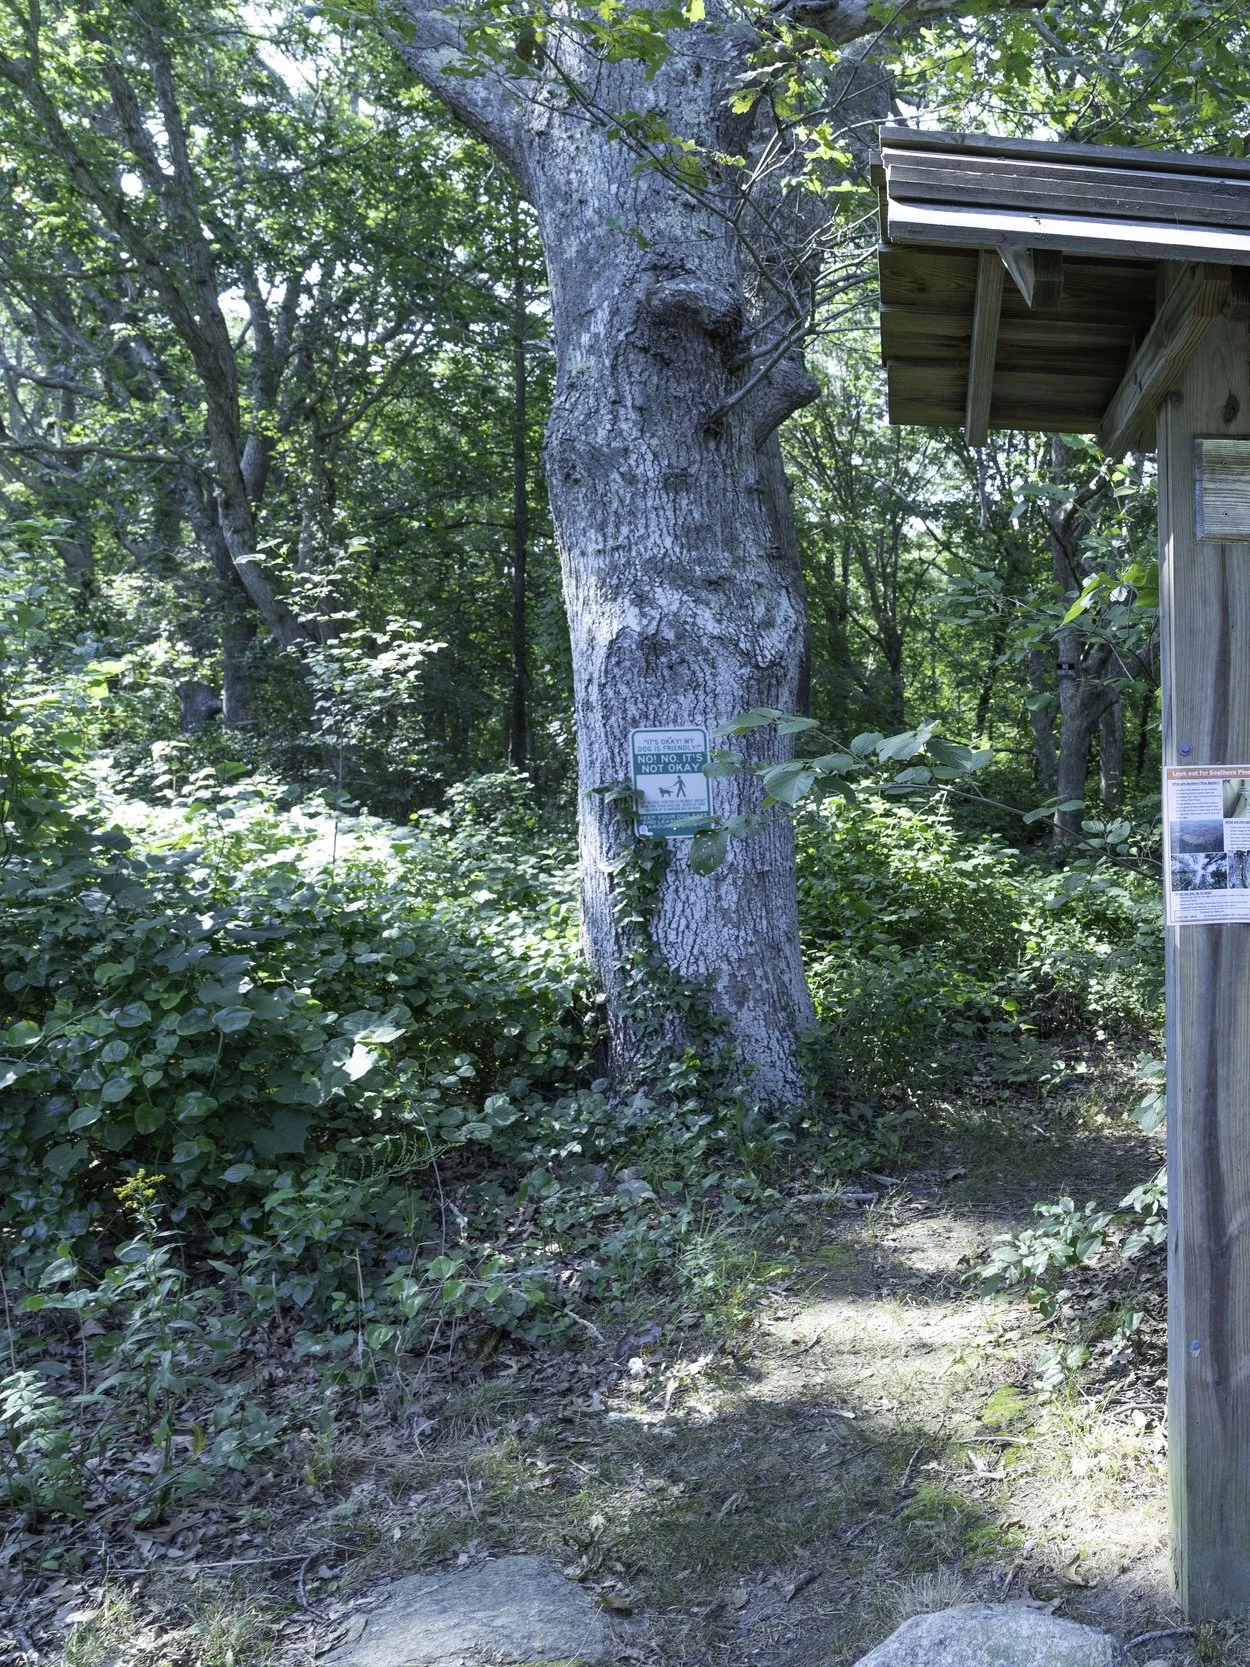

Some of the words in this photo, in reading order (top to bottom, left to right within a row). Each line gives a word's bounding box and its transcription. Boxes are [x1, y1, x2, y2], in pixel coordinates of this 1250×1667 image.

[638, 755, 656, 764] NO!
[661, 754, 679, 763] NO,
[683, 753, 703, 762] IT'S
[642, 764, 664, 773] NOT
[668, 763, 699, 772] OKAY
